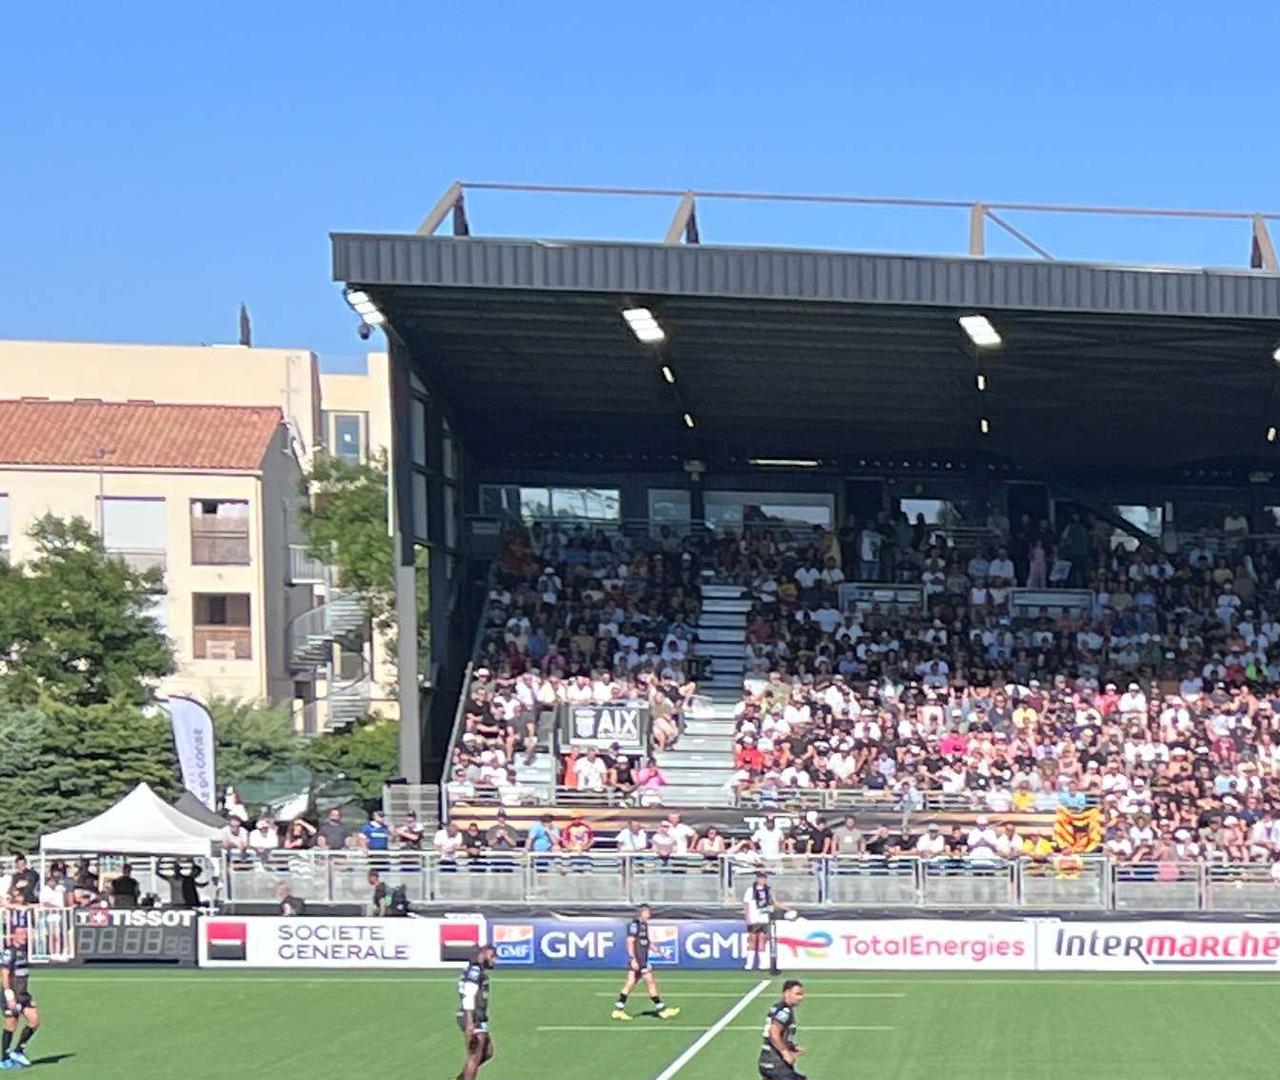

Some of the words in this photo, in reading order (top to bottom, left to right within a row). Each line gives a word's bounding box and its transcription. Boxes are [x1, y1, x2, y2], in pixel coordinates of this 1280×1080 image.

[598, 709, 638, 739] AIX
[107, 909, 196, 927] TISSOT
[278, 924, 385, 941] SOCIETE
[278, 944, 409, 961] GENERALE
[540, 930, 615, 959] GMF
[840, 932, 1026, 962] TotalEnergies
